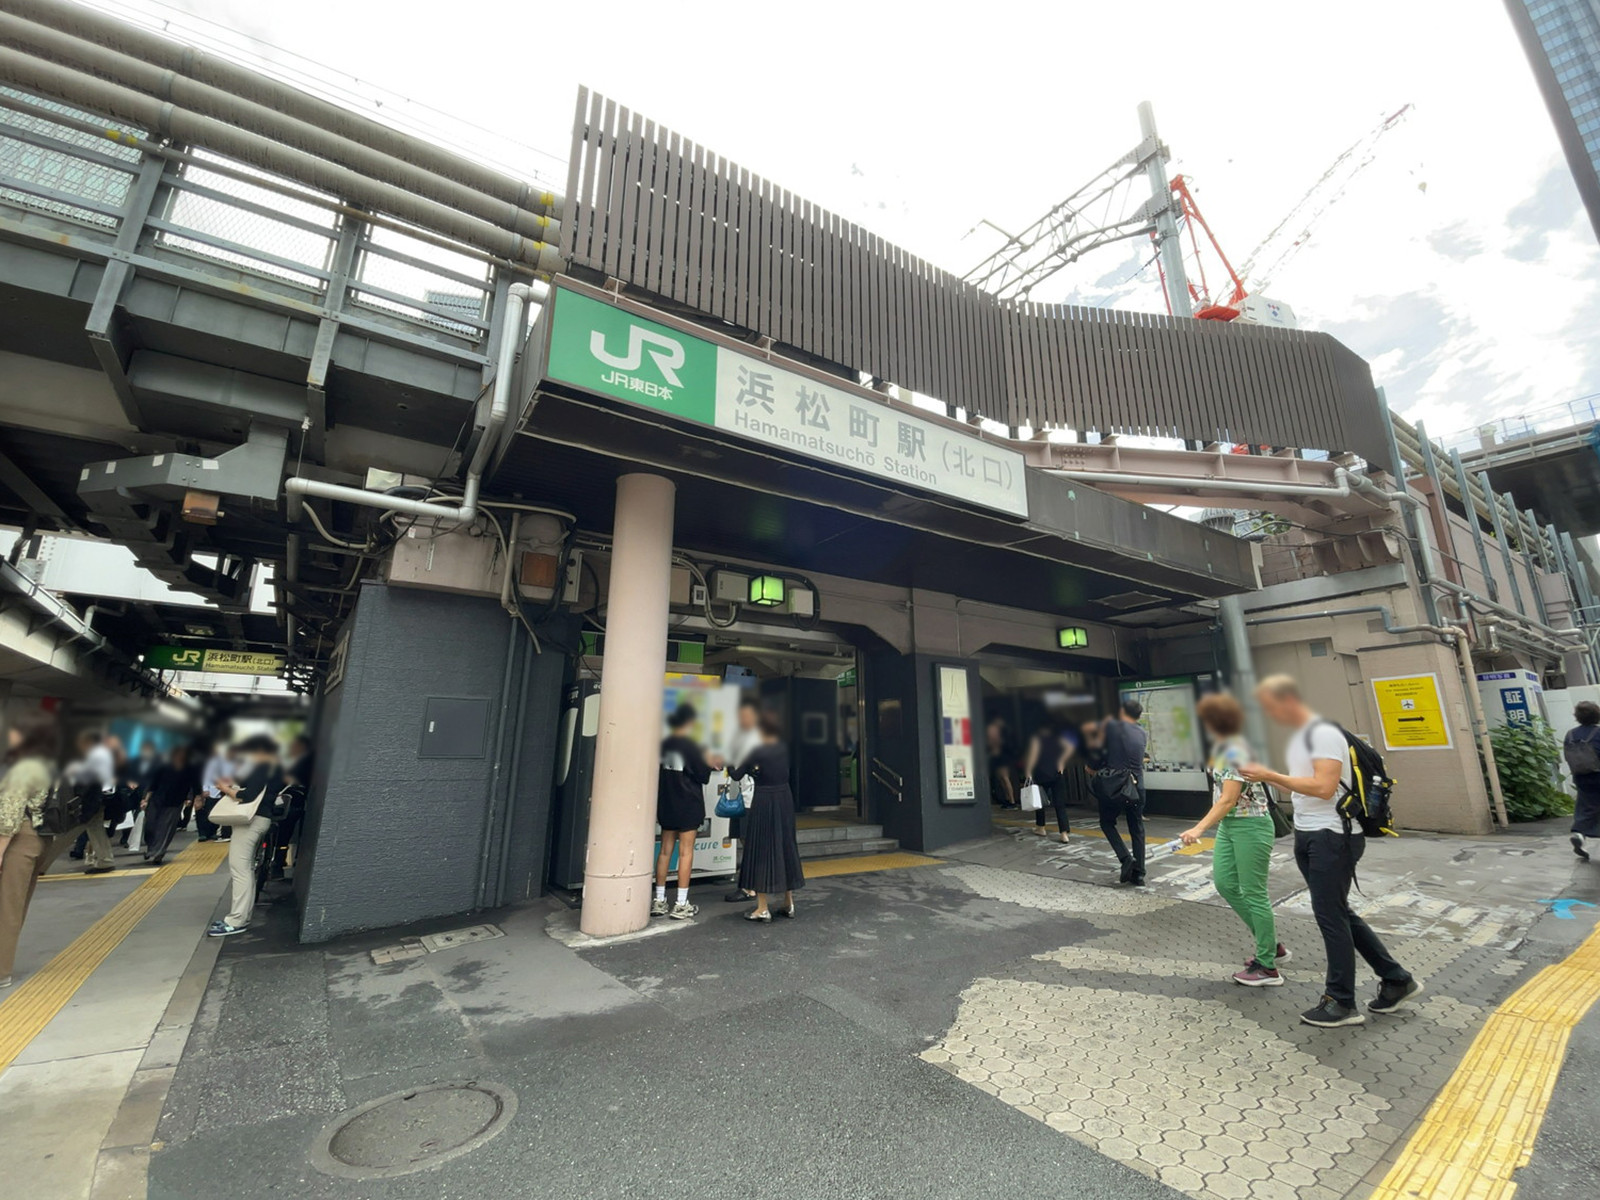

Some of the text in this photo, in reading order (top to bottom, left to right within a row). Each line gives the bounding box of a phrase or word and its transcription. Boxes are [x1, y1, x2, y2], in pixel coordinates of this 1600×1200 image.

[590, 324, 686, 389] JR
[600, 370, 673, 401] JR東日本
[735, 409, 938, 486] Hamamatsuchō Station
[172, 650, 201, 664] JR
